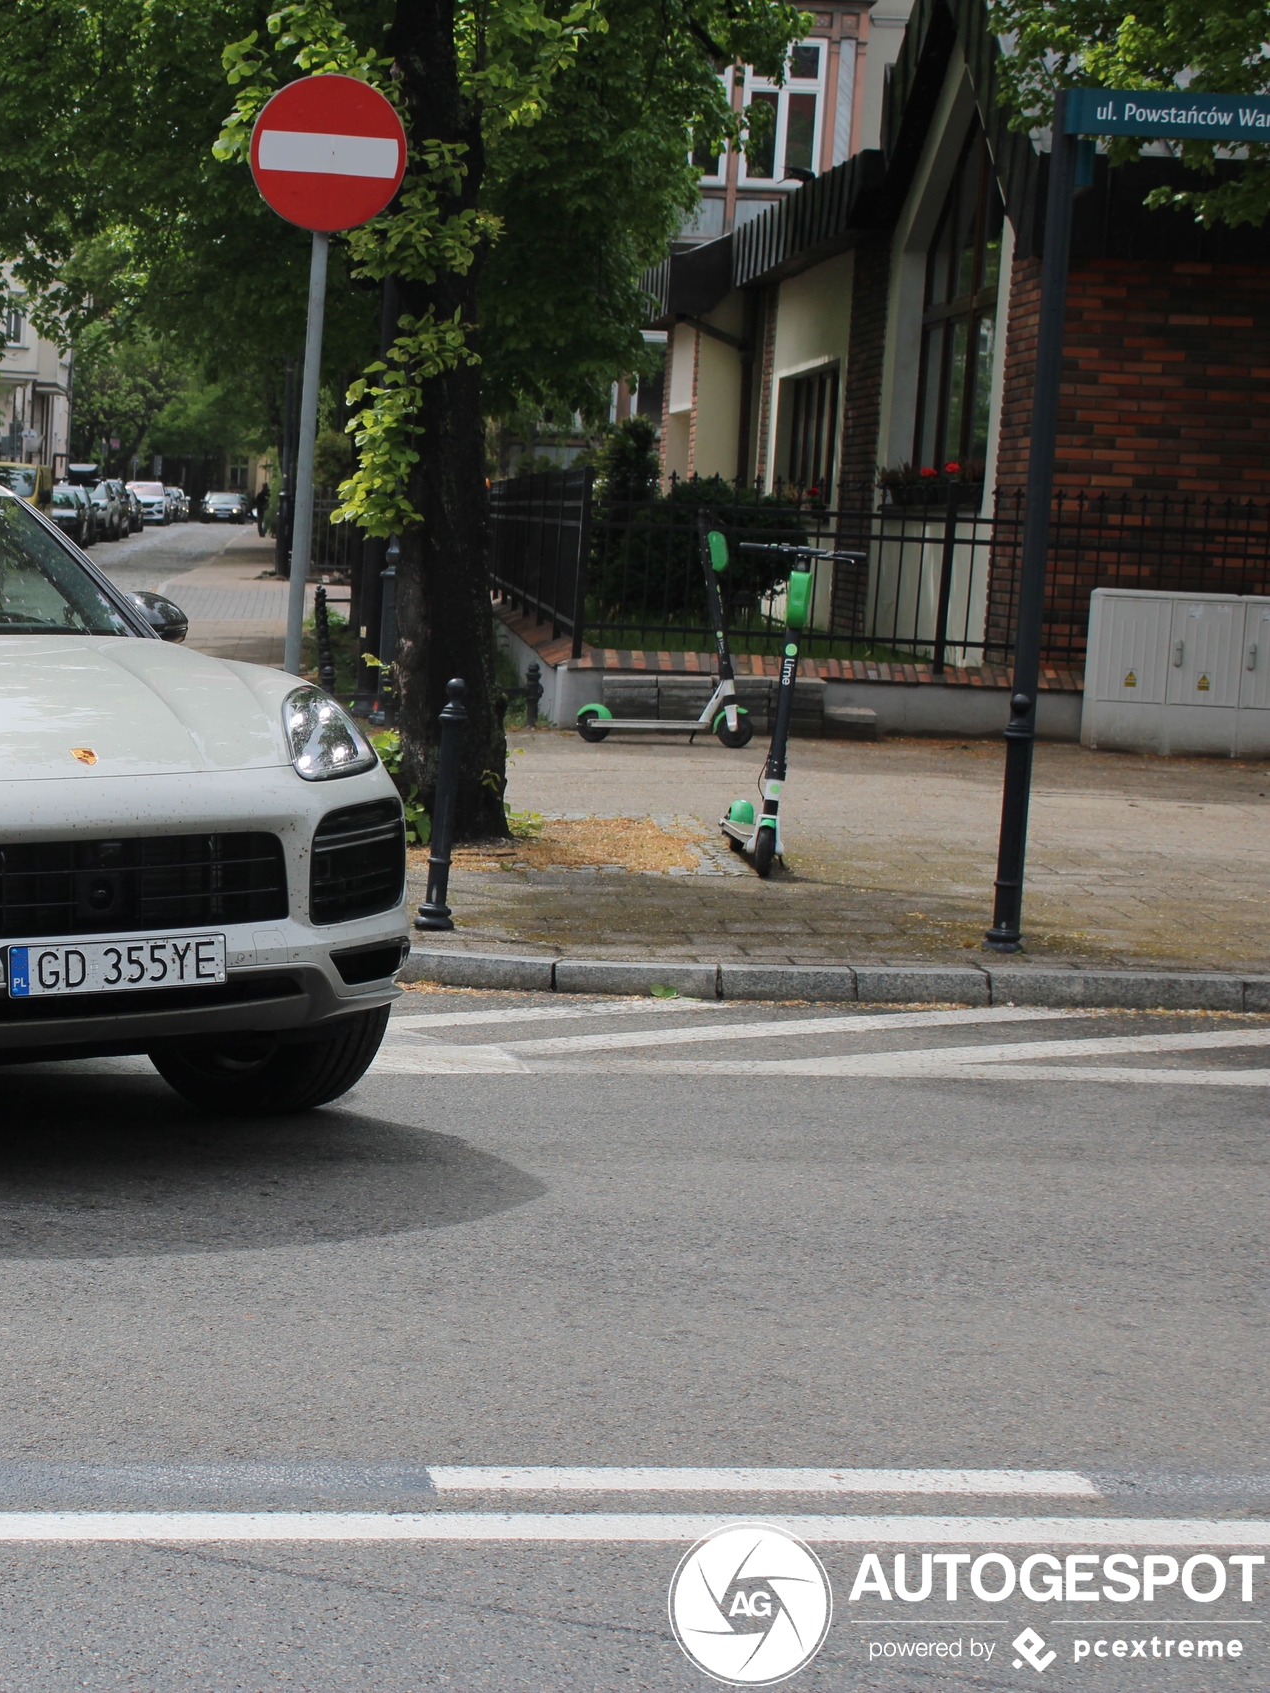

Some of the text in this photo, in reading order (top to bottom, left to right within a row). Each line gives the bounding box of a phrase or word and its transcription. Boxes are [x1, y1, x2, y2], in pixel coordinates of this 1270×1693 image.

[1096, 101, 1117, 121] ul.
[1124, 103, 1233, 126] Powstańców
[781, 658, 795, 686] Lime
[38, 940, 216, 989] GD 355YE
[13, 977, 27, 988] PL
